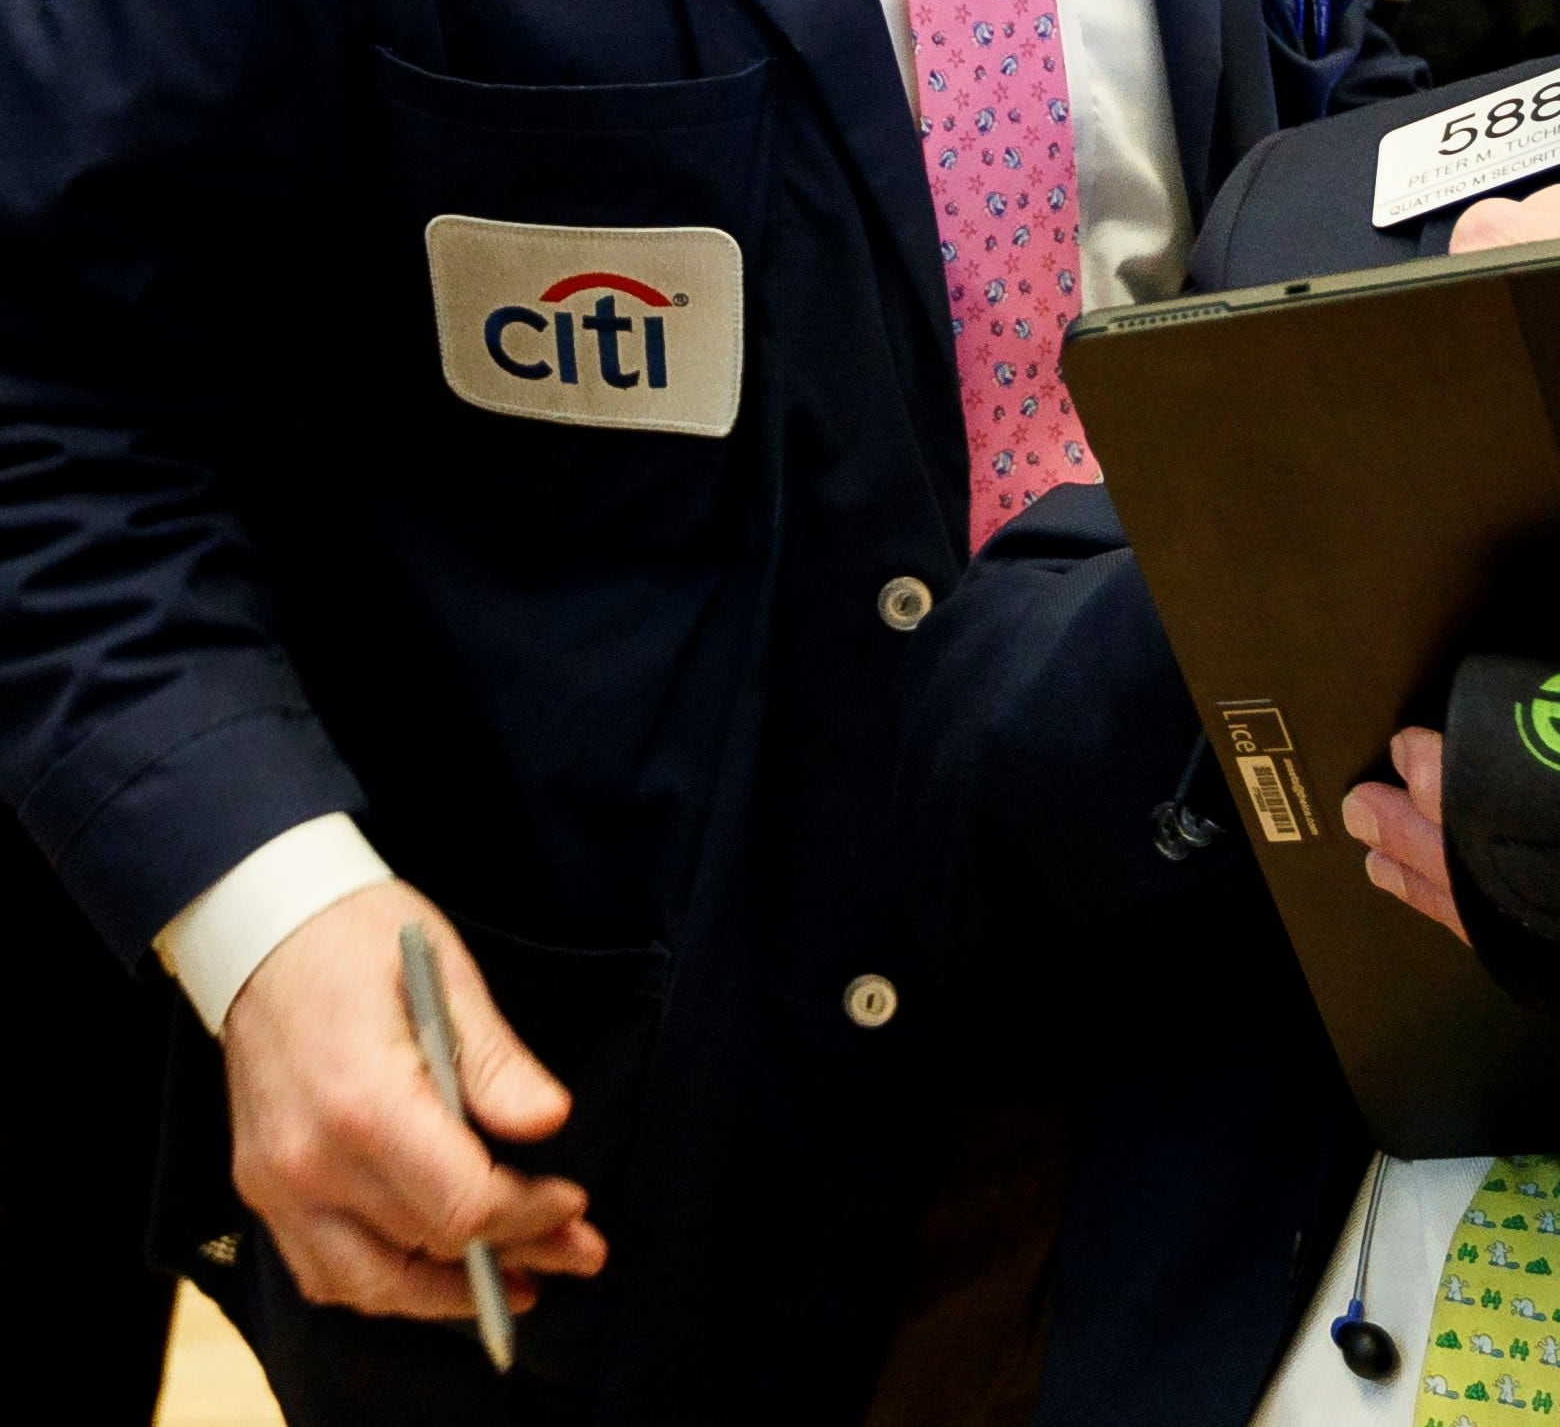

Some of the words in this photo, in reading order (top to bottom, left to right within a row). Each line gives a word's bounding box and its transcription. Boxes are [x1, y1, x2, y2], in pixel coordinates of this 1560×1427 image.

[1408, 156, 1469, 188] PETER
[1474, 147, 1495, 163] M.
[1389, 181, 1467, 216] QUATTRO
